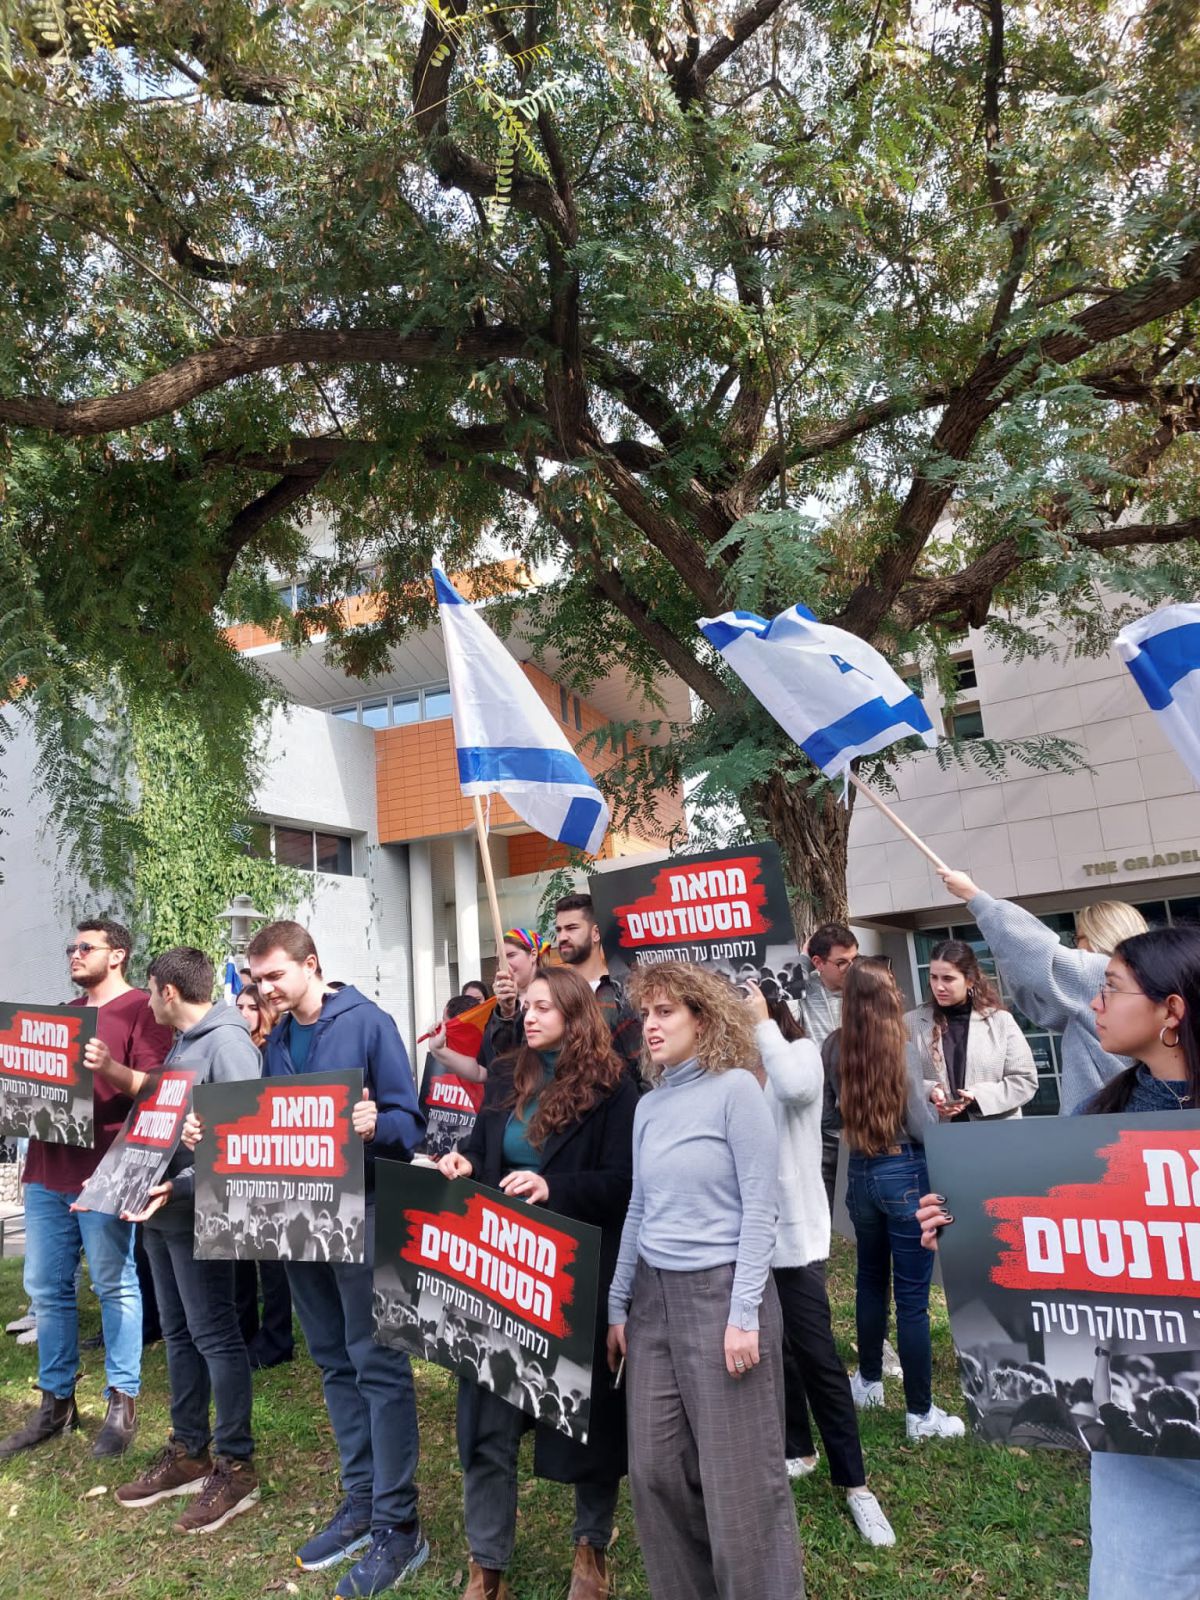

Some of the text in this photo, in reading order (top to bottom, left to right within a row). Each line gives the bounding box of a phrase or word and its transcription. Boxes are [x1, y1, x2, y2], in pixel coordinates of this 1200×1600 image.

[669, 867, 747, 903] מחאת
[1082, 861, 1118, 876] THE
[626, 900, 752, 940] הסטודנטים
[691, 945, 708, 962] על
[711, 940, 757, 960] נלחמים
[20, 1018, 69, 1049] מחאת
[0, 1043, 68, 1079] הסטודנטי
[0, 1077, 68, 1104] נלחמים על הדמוקר
[432, 1082, 474, 1108] ודנטים
[271, 1096, 335, 1128] מחאת
[459, 1113, 469, 1126] על
[227, 1134, 335, 1168] הסטודנטים
[226, 1179, 334, 1202] נלחמים על הדמוקרטיה
[479, 1207, 557, 1278] מחאת
[1022, 1216, 1200, 1282] ודנטים
[420, 1223, 553, 1322] הסטודנטים
[416, 1271, 549, 1358] נלחמים על הדמוקרטיה
[1031, 1301, 1187, 1344] הדמוקרטיה
